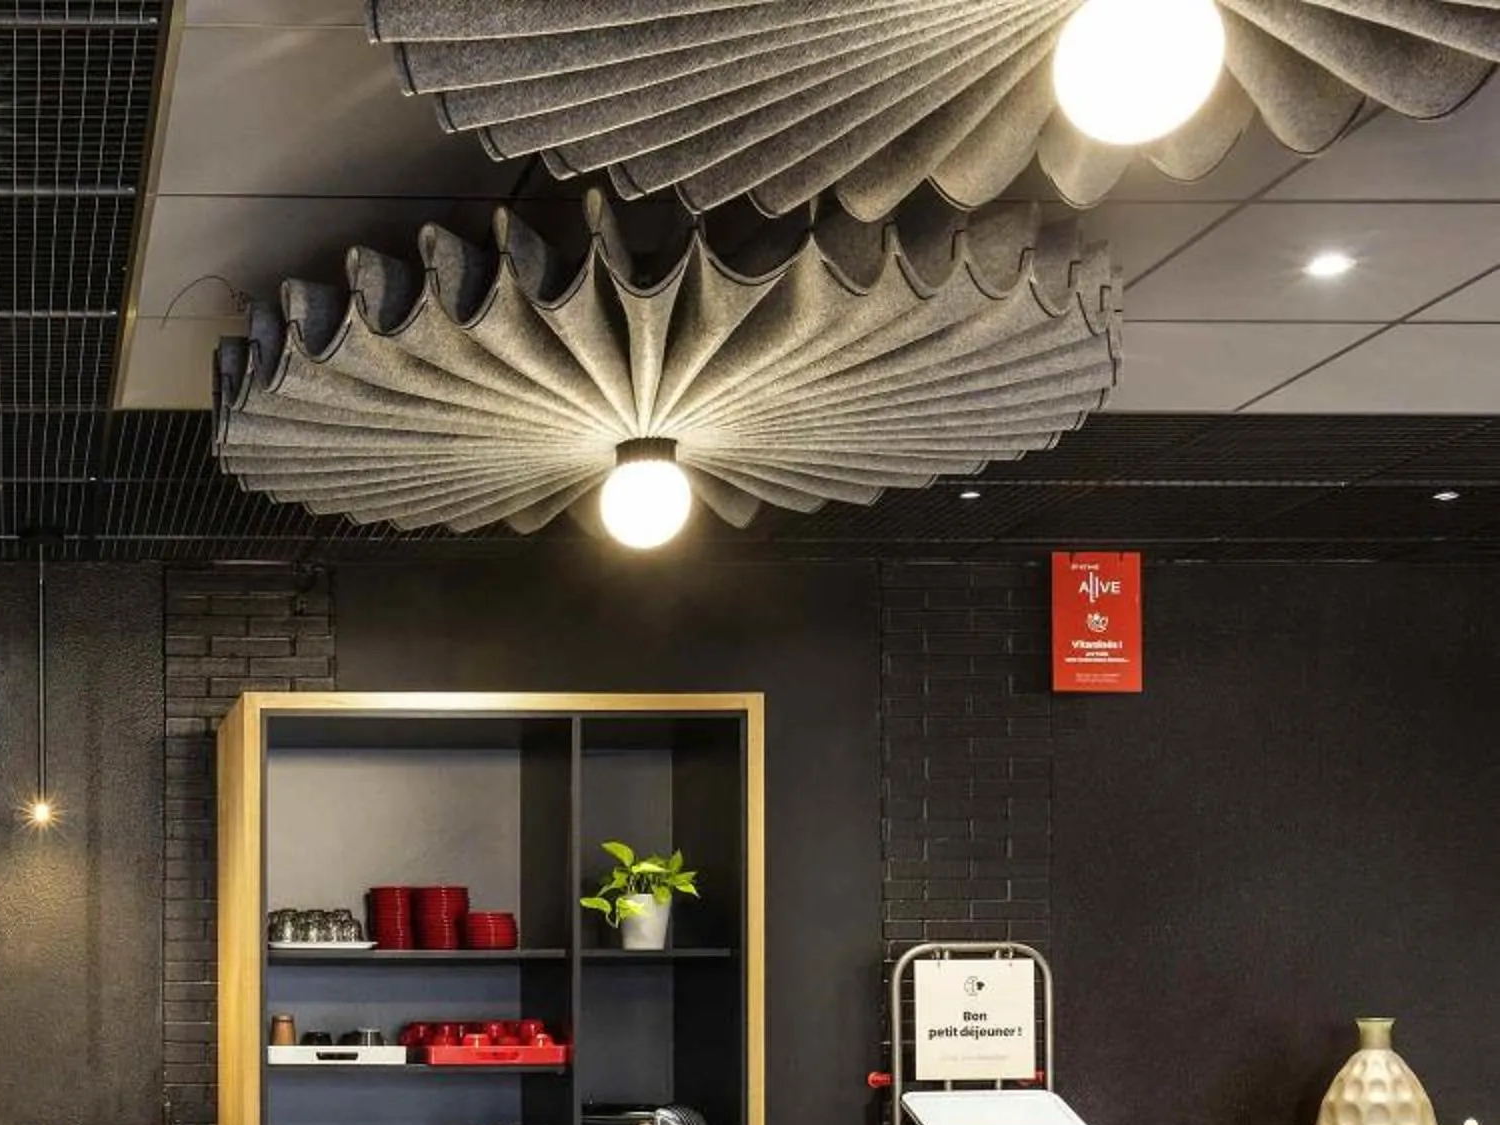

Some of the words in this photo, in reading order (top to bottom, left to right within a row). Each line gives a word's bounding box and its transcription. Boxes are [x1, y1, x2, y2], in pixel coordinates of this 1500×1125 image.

[963, 1011, 987, 1021] Bon
[928, 1025, 958, 1040] petit
[960, 1025, 1015, 1040] déjeuner
